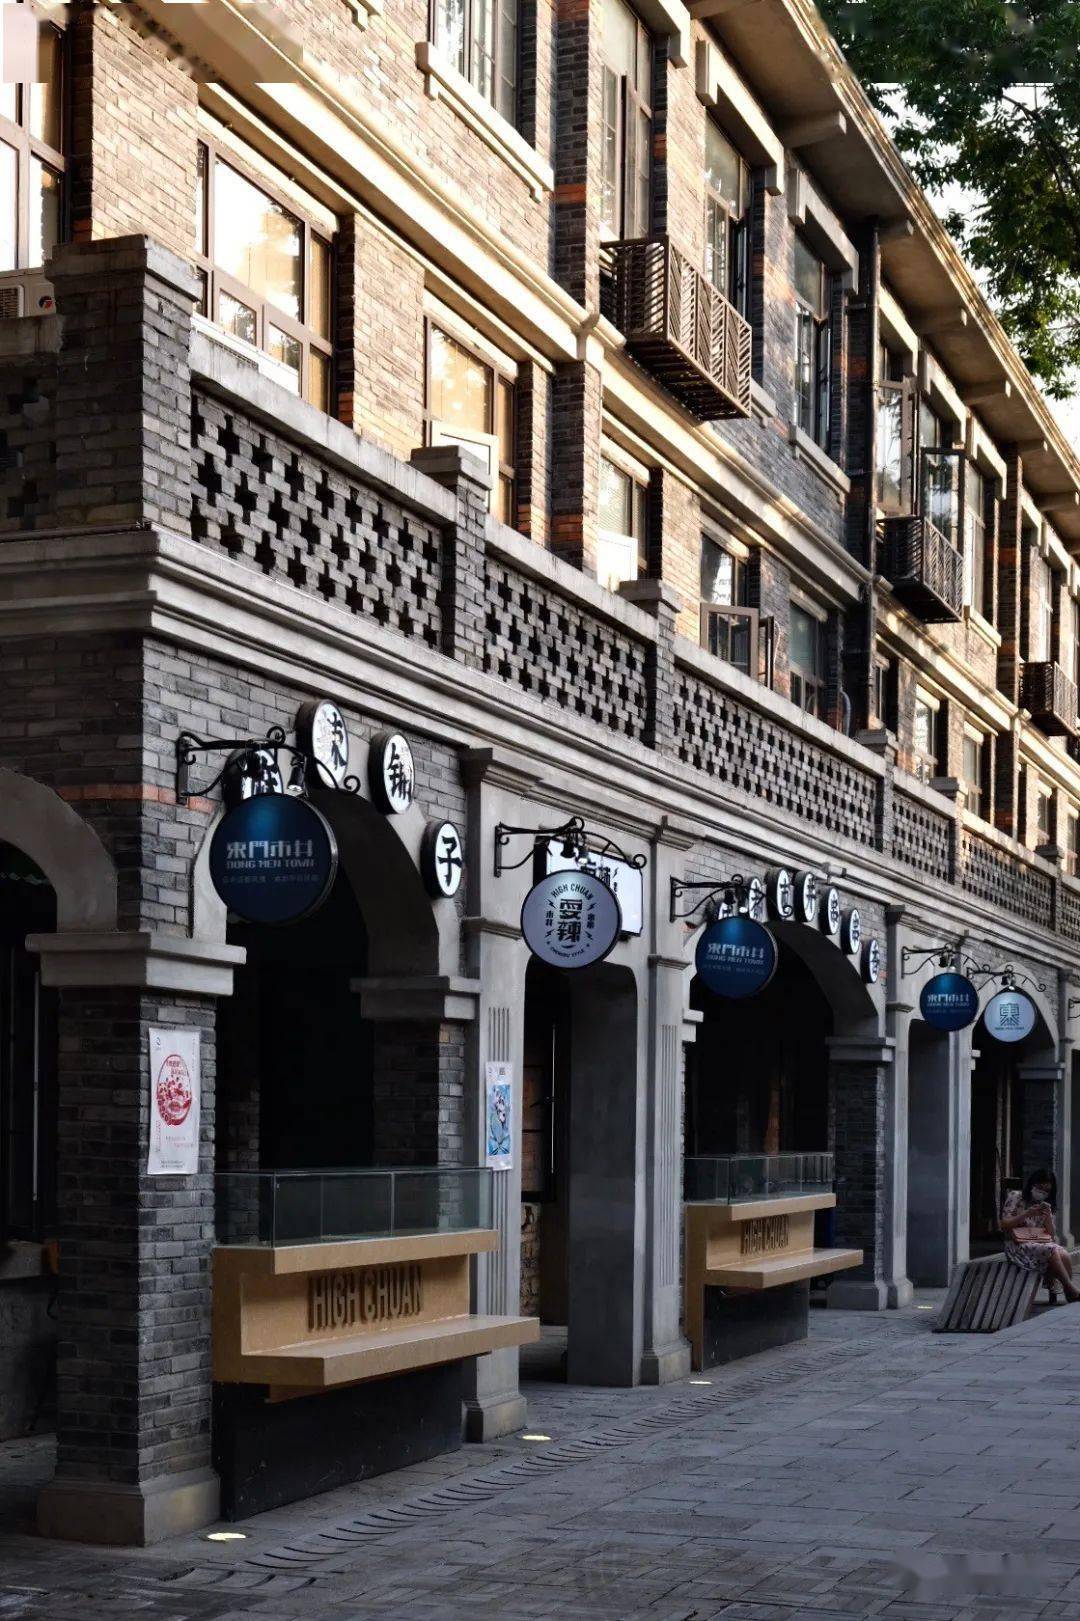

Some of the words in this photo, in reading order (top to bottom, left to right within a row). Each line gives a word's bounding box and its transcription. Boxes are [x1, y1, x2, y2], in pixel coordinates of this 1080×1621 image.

[551, 883, 569, 898] HIGH
[570, 883, 594, 900] CHUAN
[308, 1271, 361, 1332] HIGH
[362, 1263, 423, 1323] CHUAN
